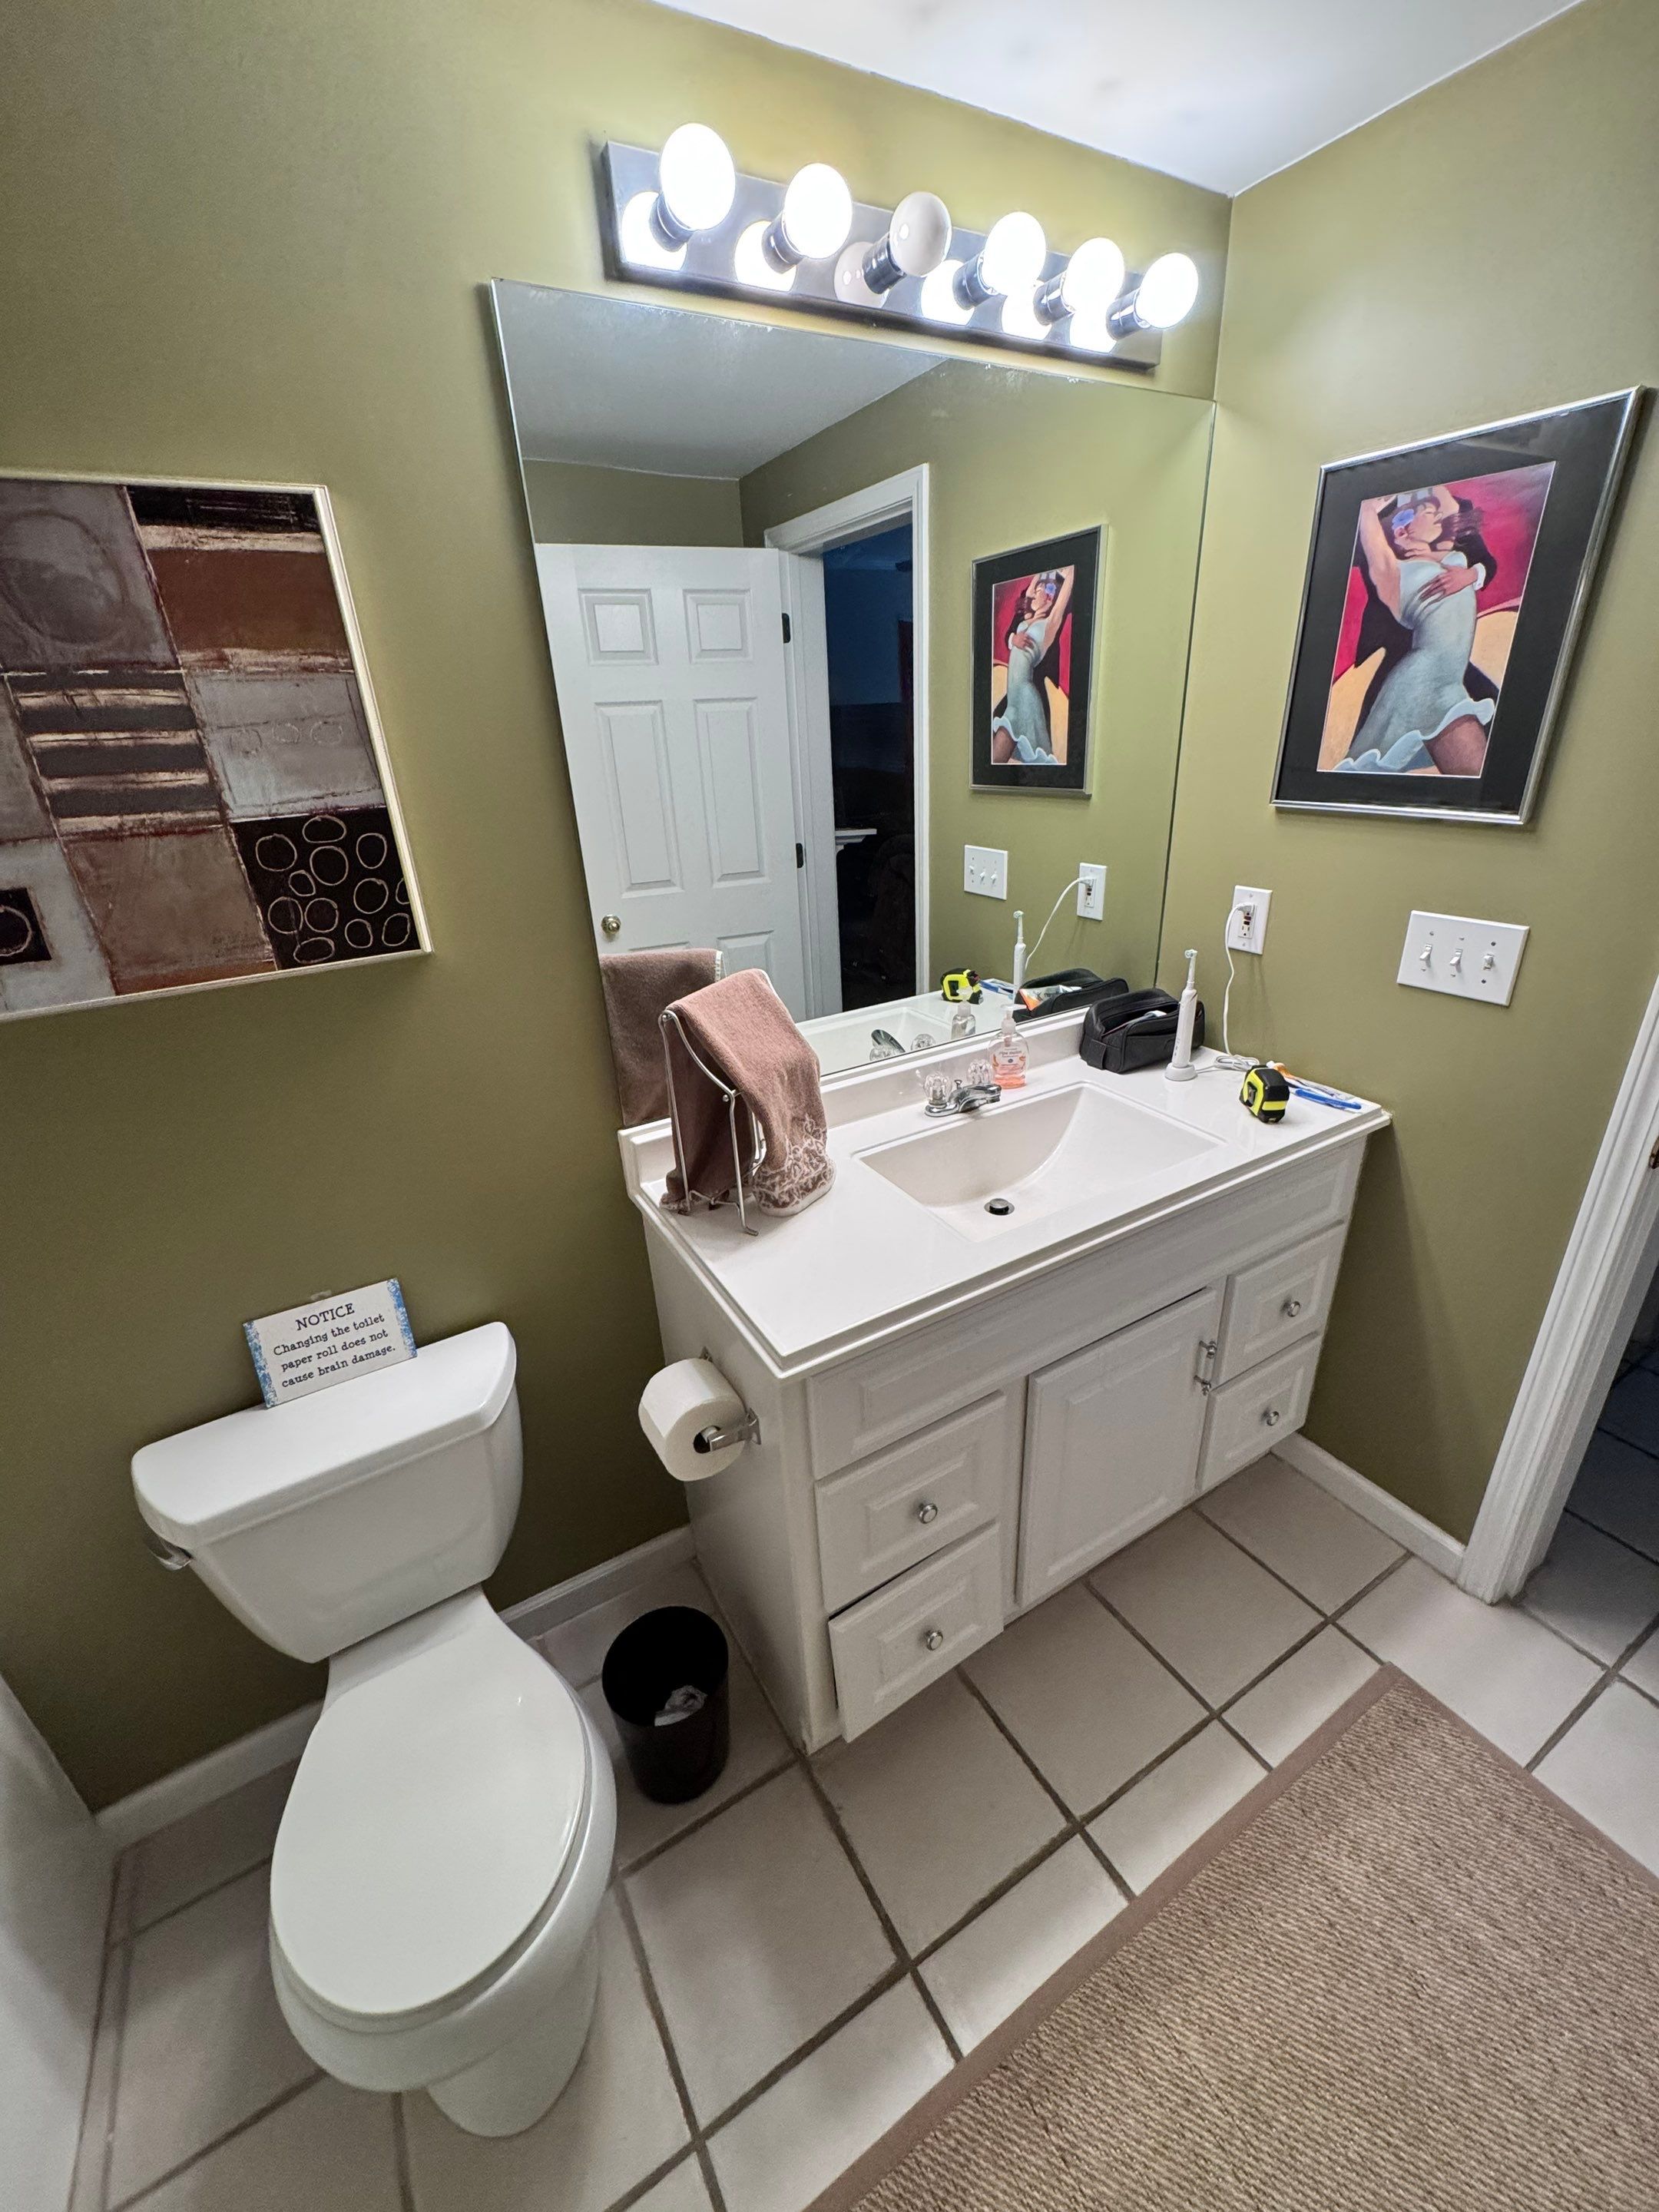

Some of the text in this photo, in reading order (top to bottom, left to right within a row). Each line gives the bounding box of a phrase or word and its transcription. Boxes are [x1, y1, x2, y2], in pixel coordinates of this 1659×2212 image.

[273, 1313, 385, 1356] Changing the toilet
[295, 1303, 355, 1331] NOTICE
[281, 1329, 389, 1373] paper roll does not
[282, 1346, 396, 1388] cause brain damage.
